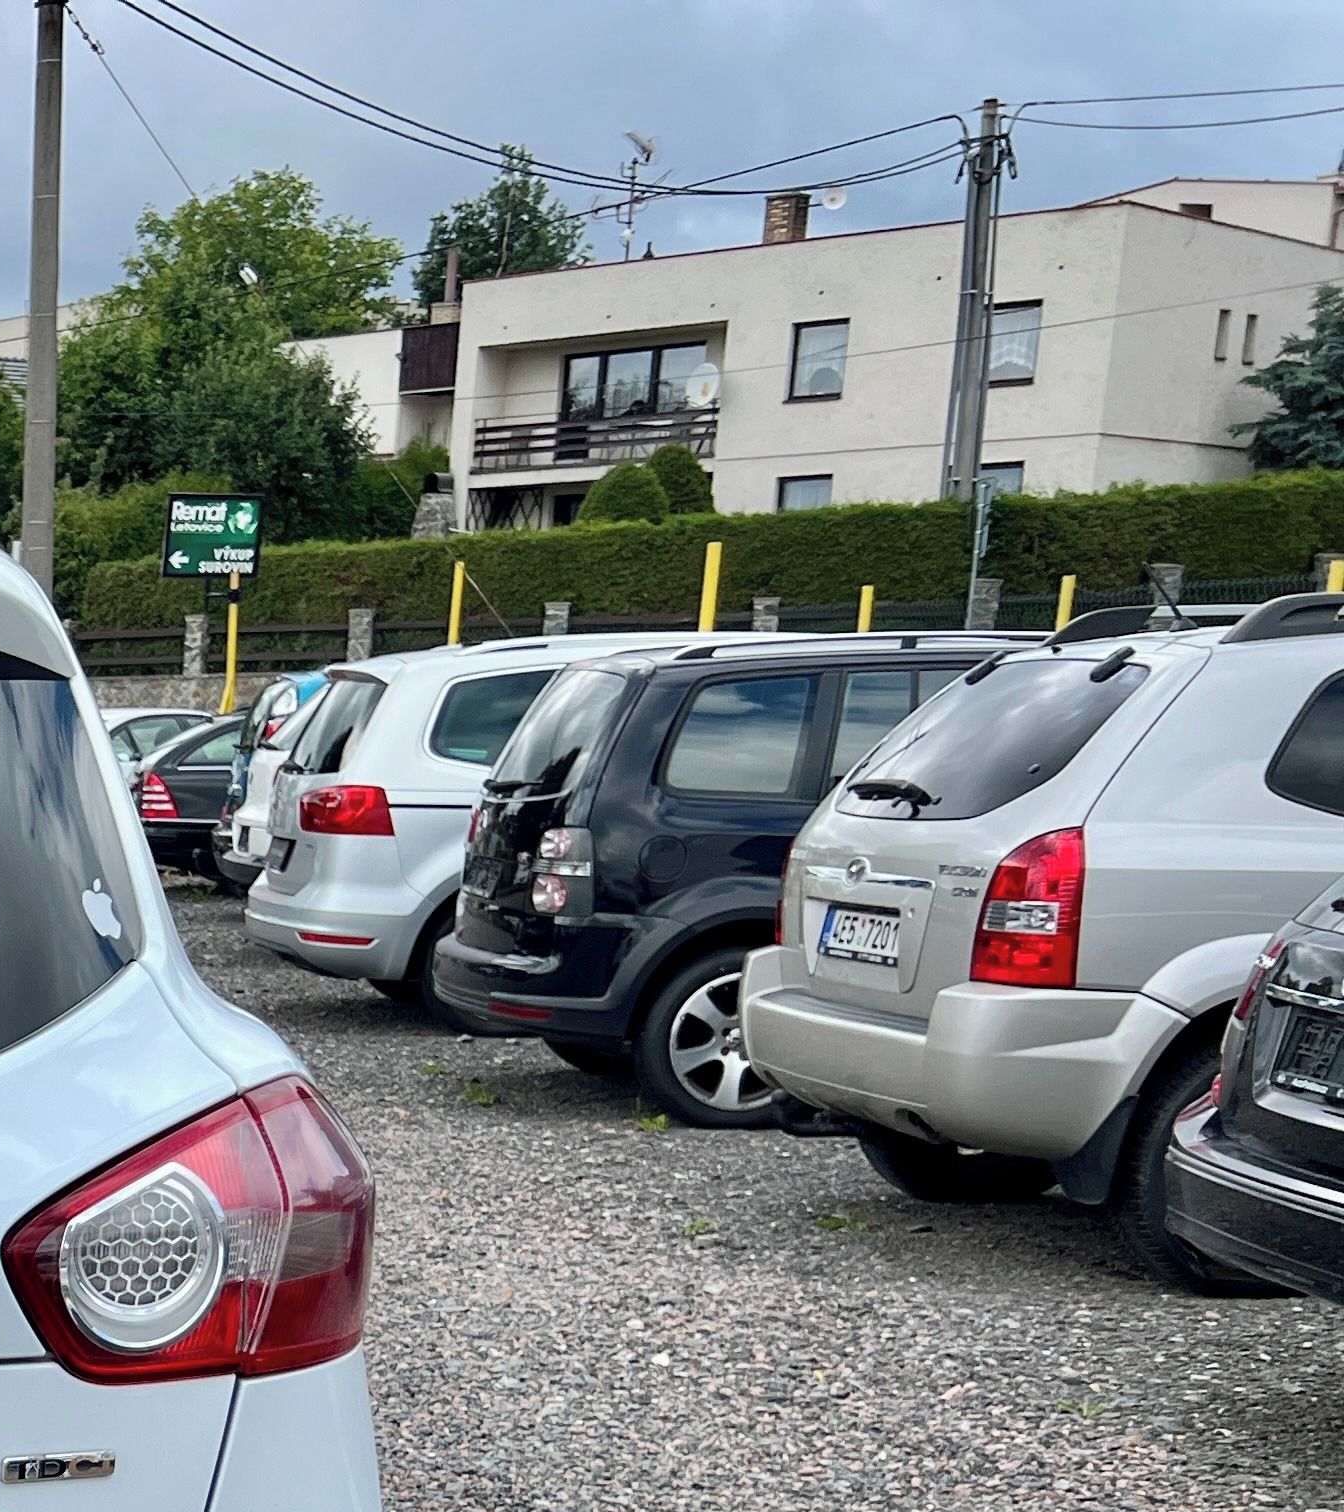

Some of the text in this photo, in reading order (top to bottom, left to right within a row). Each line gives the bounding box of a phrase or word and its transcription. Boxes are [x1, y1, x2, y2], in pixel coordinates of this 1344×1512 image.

[172, 501, 228, 521] Remat
[170, 522, 224, 533] Letovice
[214, 545, 255, 561] VÝKUP
[833, 914, 900, 953] 4E5 7201
